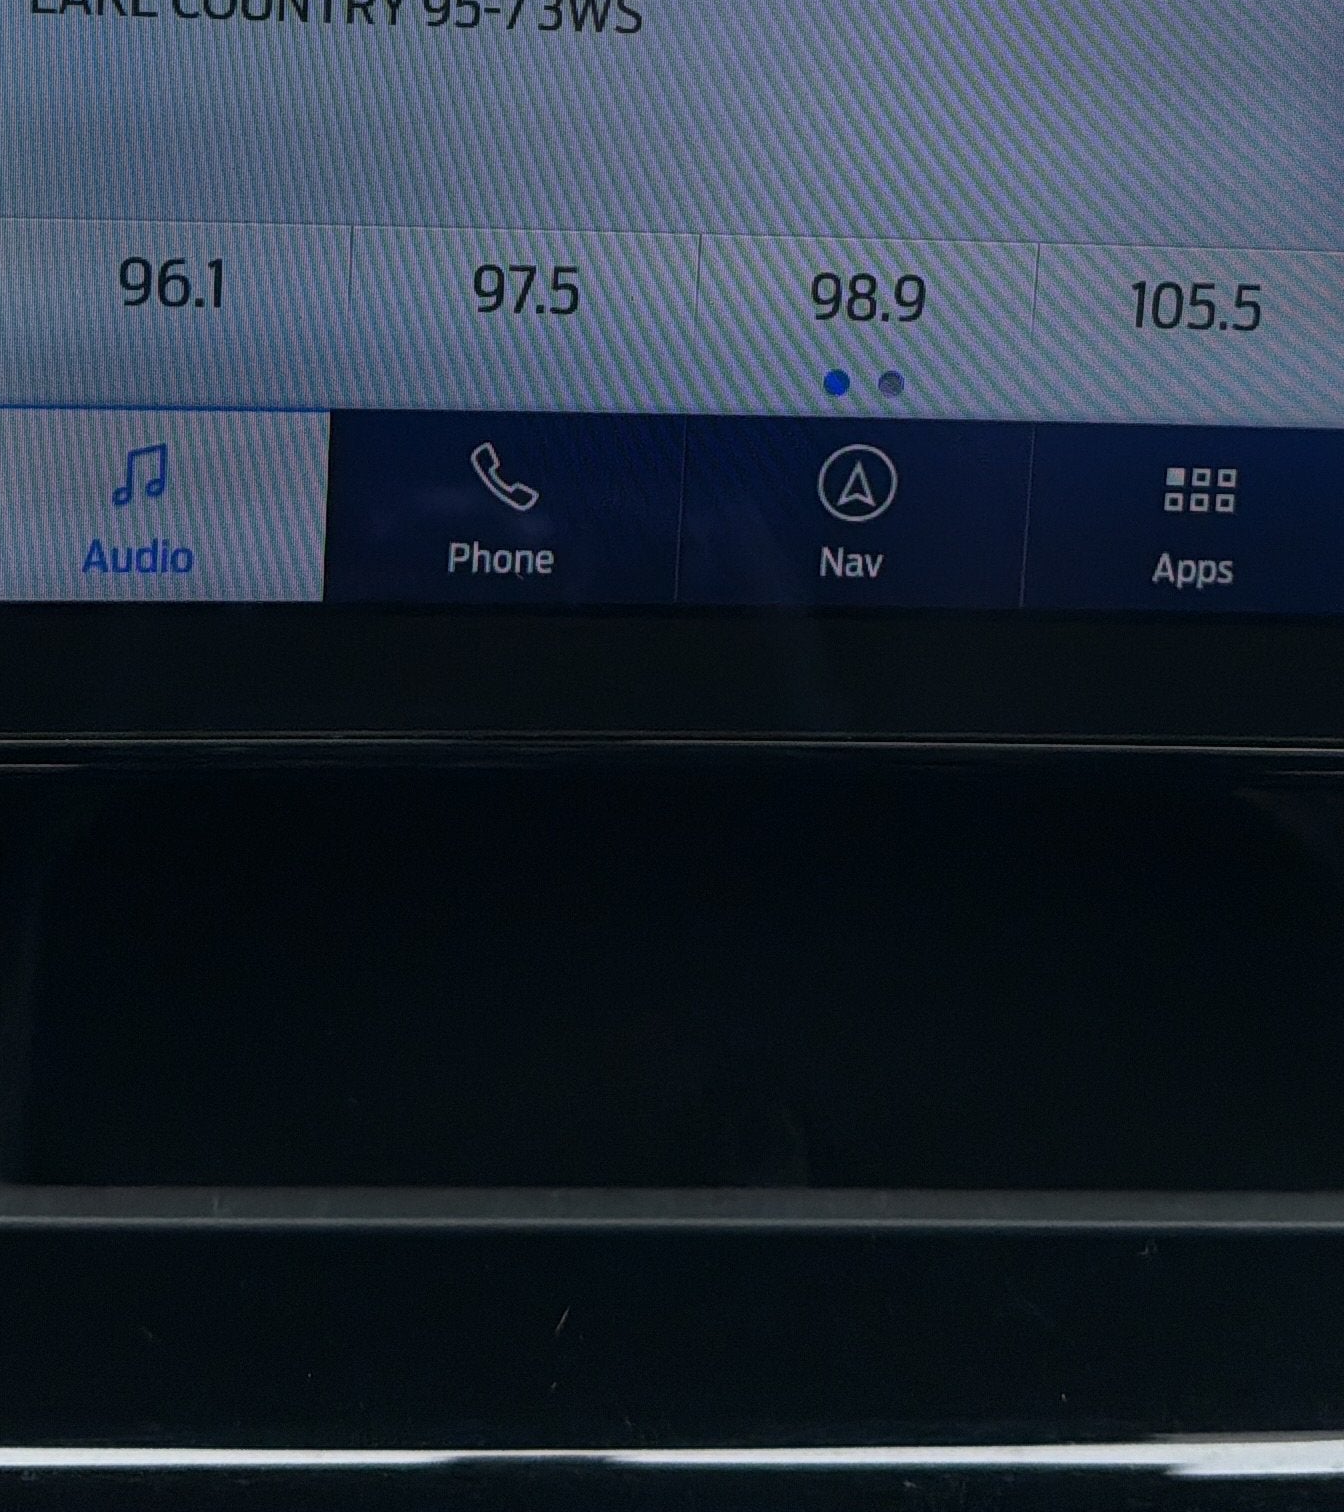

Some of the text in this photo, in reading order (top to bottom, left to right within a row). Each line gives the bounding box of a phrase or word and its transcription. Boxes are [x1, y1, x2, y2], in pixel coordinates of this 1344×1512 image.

[118, 256, 225, 310] 96.1
[474, 263, 581, 317] 97.5
[810, 272, 927, 324] 98.9
[1131, 280, 1263, 333] 105.5
[82, 538, 195, 576] Audio
[448, 542, 555, 576] Phone
[819, 545, 884, 580] Nav
[1152, 551, 1235, 590] Apps
